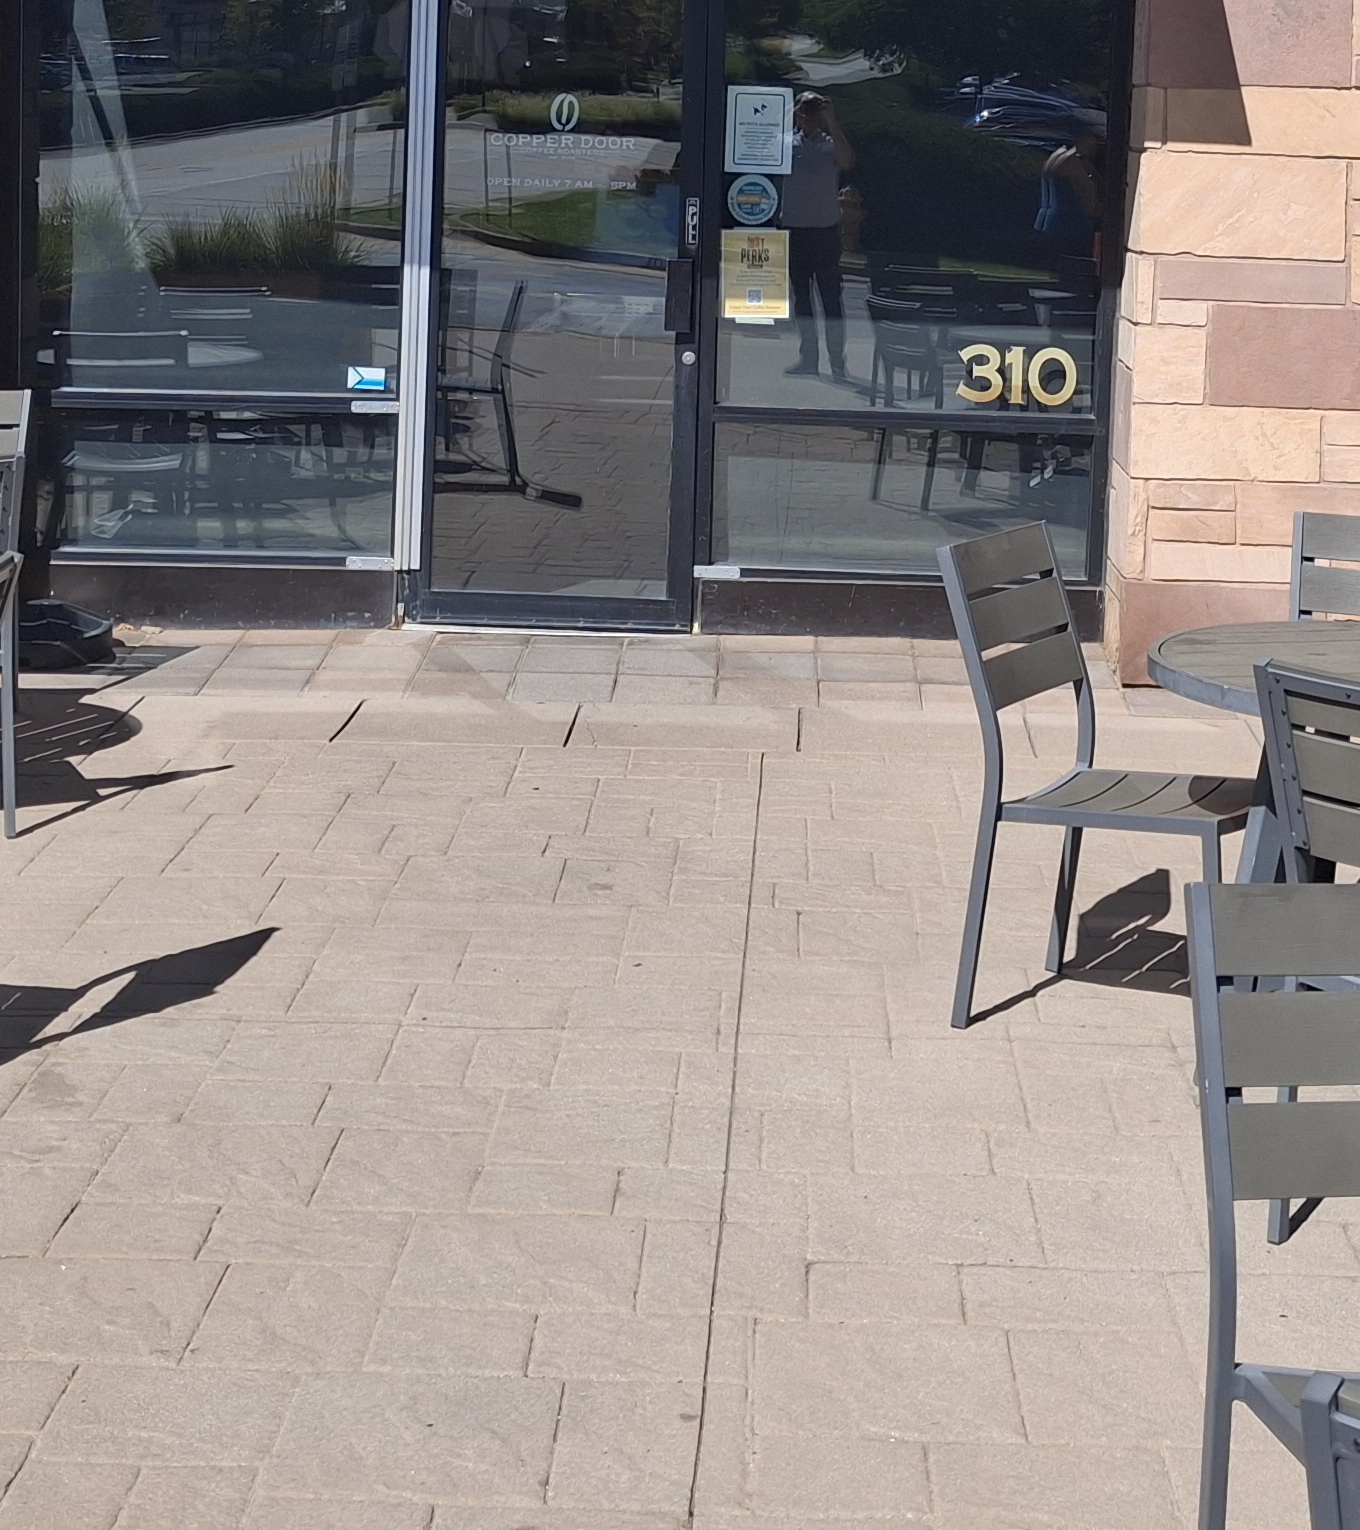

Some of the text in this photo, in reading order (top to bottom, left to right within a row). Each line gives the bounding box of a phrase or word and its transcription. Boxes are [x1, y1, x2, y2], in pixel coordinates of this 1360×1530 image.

[490, 133, 635, 150] COPPER DOOR
[519, 147, 605, 156] COFFEE ROASTERS
[487, 176, 521, 186] OPEN
[523, 178, 561, 188] DAILY
[564, 180, 572, 188] 7
[574, 180, 594, 189] AM
[688, 205, 697, 244] PULL
[740, 247, 770, 265] PERKS
[956, 343, 1078, 406] 310
